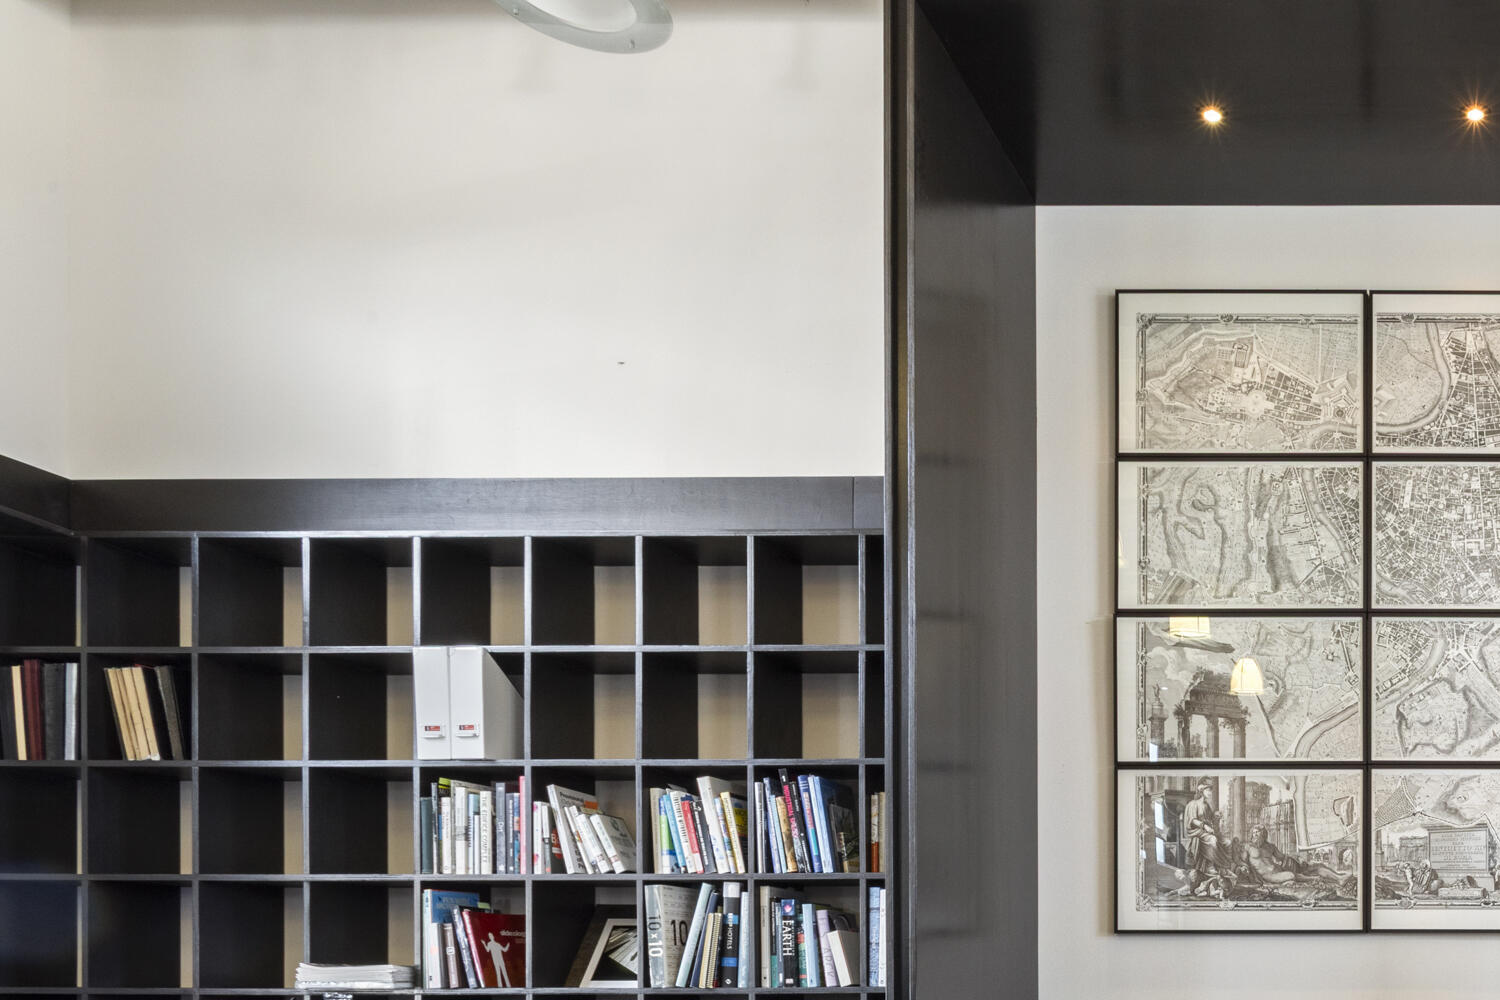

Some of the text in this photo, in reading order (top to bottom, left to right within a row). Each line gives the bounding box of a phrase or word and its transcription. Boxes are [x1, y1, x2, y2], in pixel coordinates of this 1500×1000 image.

[670, 919, 688, 946] 10
[782, 920, 792, 956] EARTH
[649, 940, 663, 957] 10
